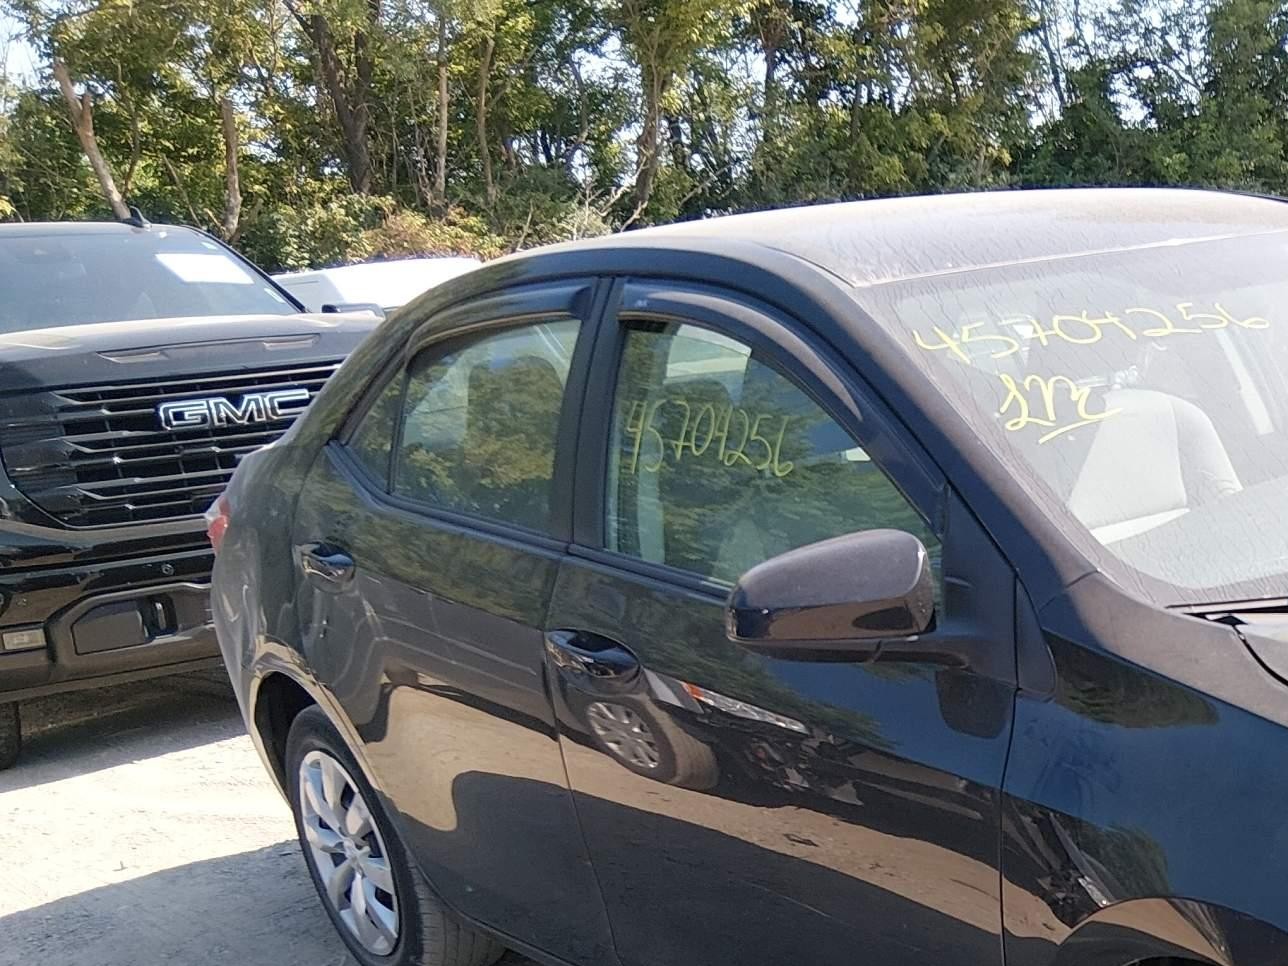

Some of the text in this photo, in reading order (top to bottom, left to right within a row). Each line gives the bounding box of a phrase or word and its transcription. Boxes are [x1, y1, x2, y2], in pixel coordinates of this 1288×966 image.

[911, 302, 1271, 364] 45704256
[158, 387, 311, 431] GMC
[626, 398, 795, 479] 45704256
